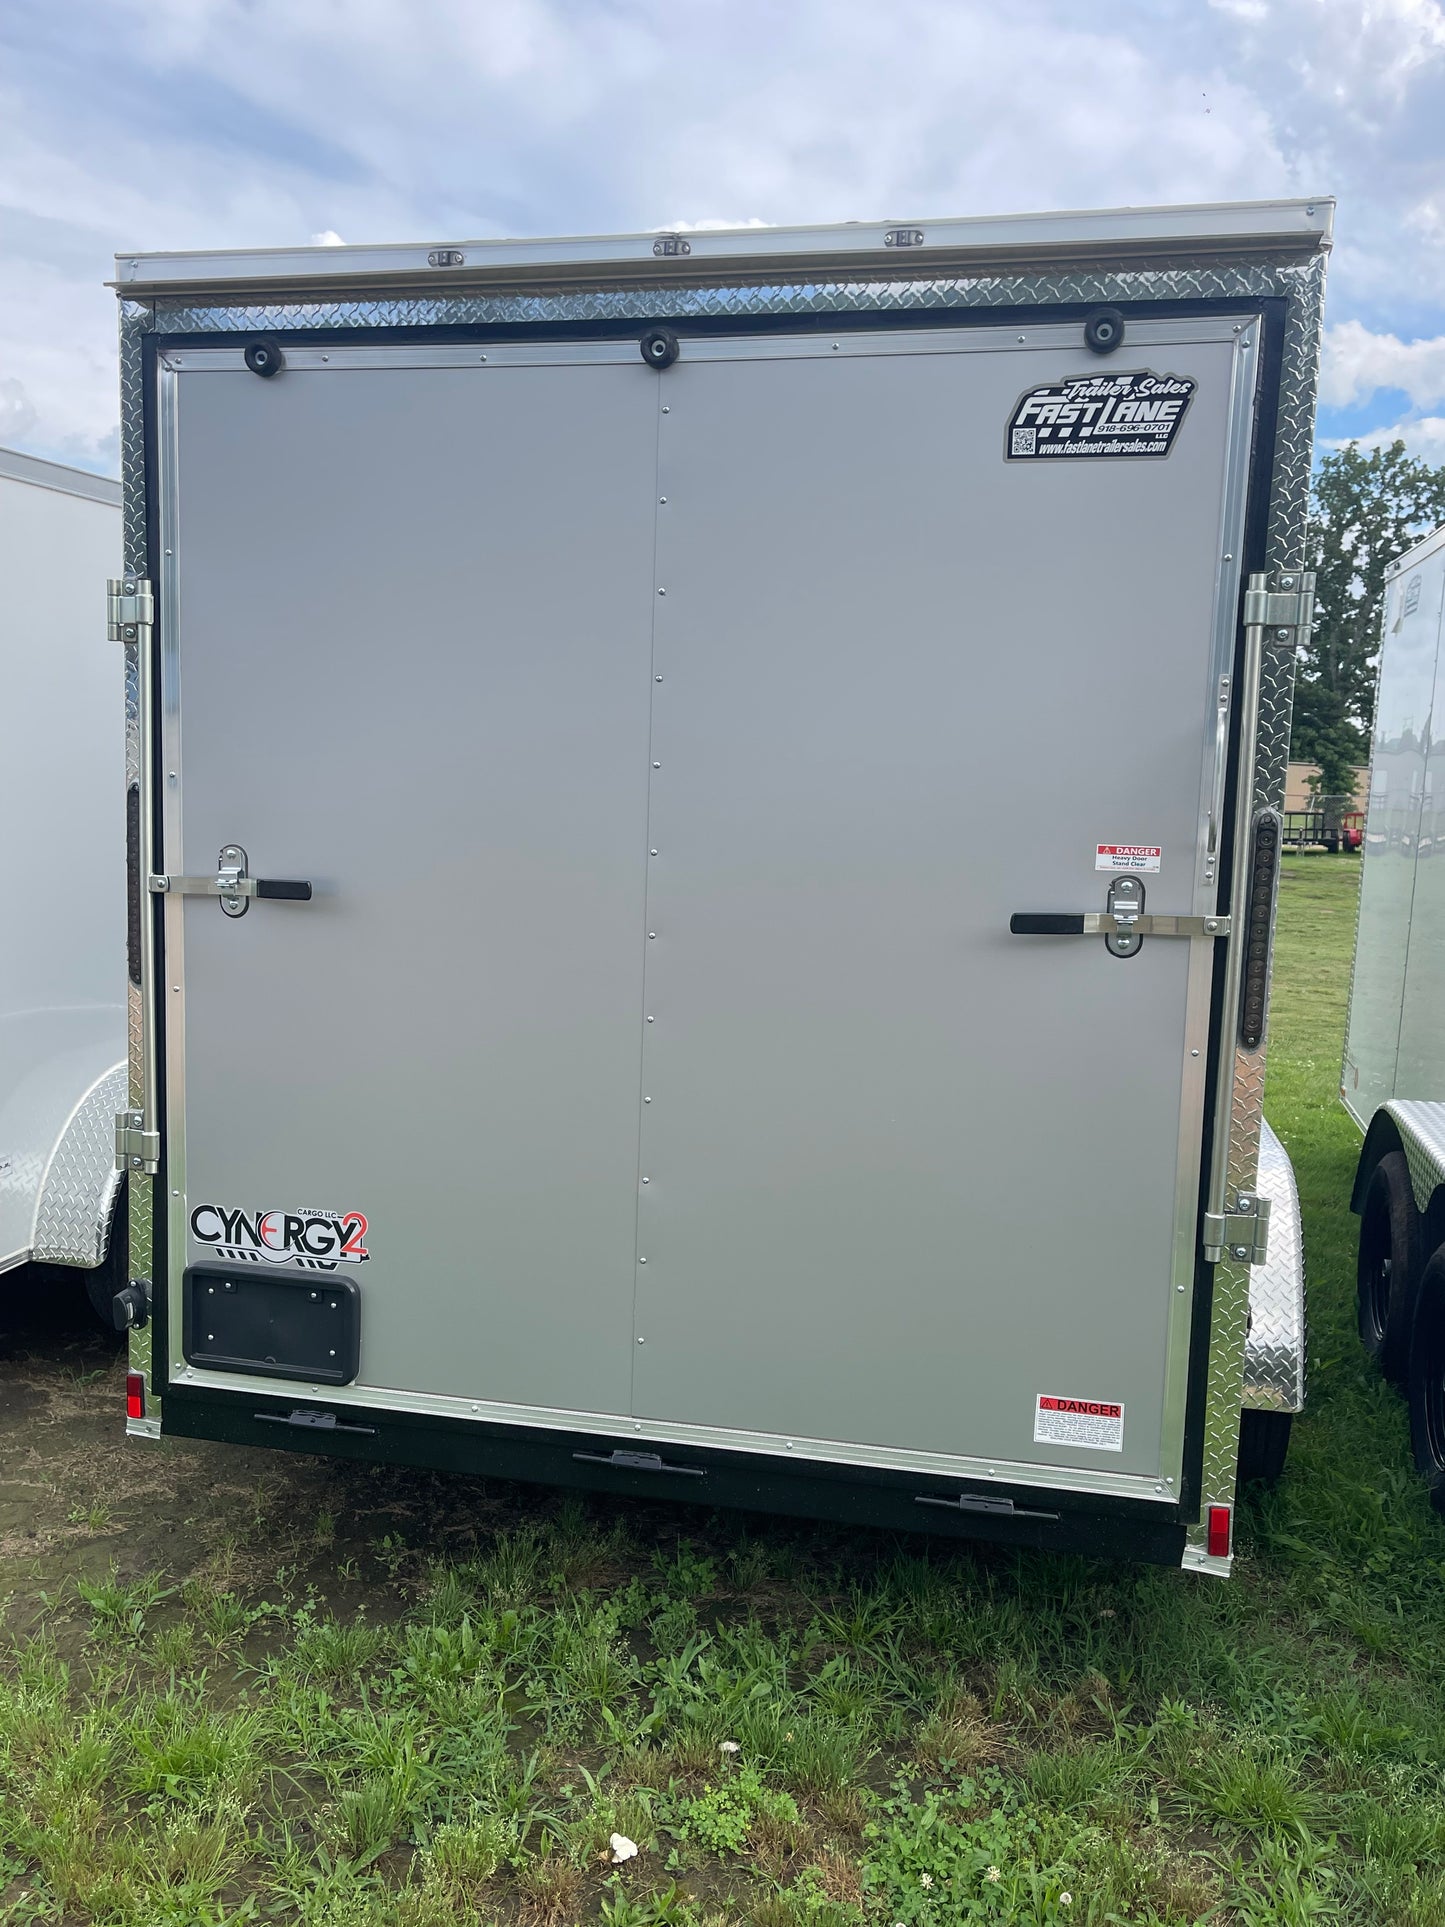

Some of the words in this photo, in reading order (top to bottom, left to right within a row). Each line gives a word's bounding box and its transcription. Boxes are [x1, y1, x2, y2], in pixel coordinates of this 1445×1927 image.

[1067, 380, 1134, 400] Trailer
[1136, 378, 1192, 398] Sales
[1097, 423, 1171, 433] 918-696-0701
[1038, 439, 1168, 454] www.fastlanetrailersales.com
[1116, 847, 1157, 856] DANGER
[297, 1208, 323, 1218] CARGO
[325, 1211, 337, 1219] LLC
[1057, 1399, 1119, 1417] DANGER
